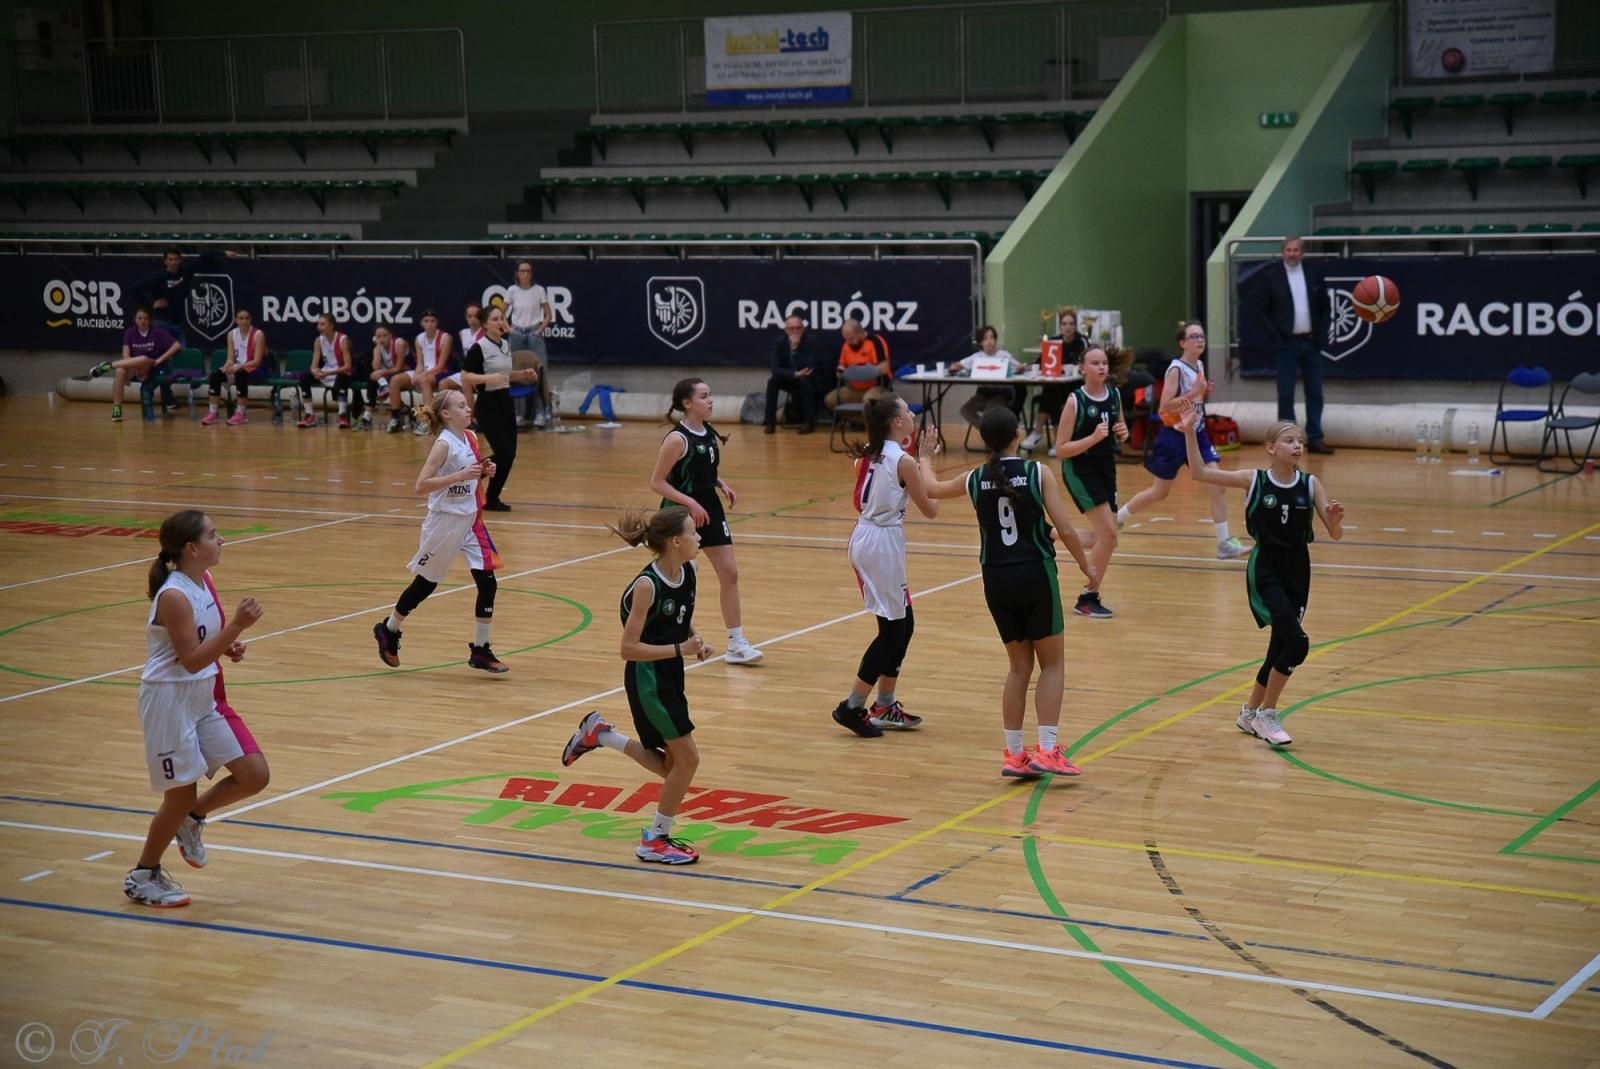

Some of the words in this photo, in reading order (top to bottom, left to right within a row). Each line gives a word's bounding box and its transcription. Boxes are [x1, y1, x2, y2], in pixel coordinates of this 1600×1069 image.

[261, 287, 413, 325] RACIBÓRZ
[738, 290, 919, 332] RACIBÓRZ
[1416, 289, 1600, 336] RACIBÓ
[76, 316, 125, 329] RACIBÓRZ
[1044, 344, 1059, 370] 5
[997, 496, 1019, 546] 9
[1280, 504, 1290, 525] 3
[162, 757, 175, 780] 9
